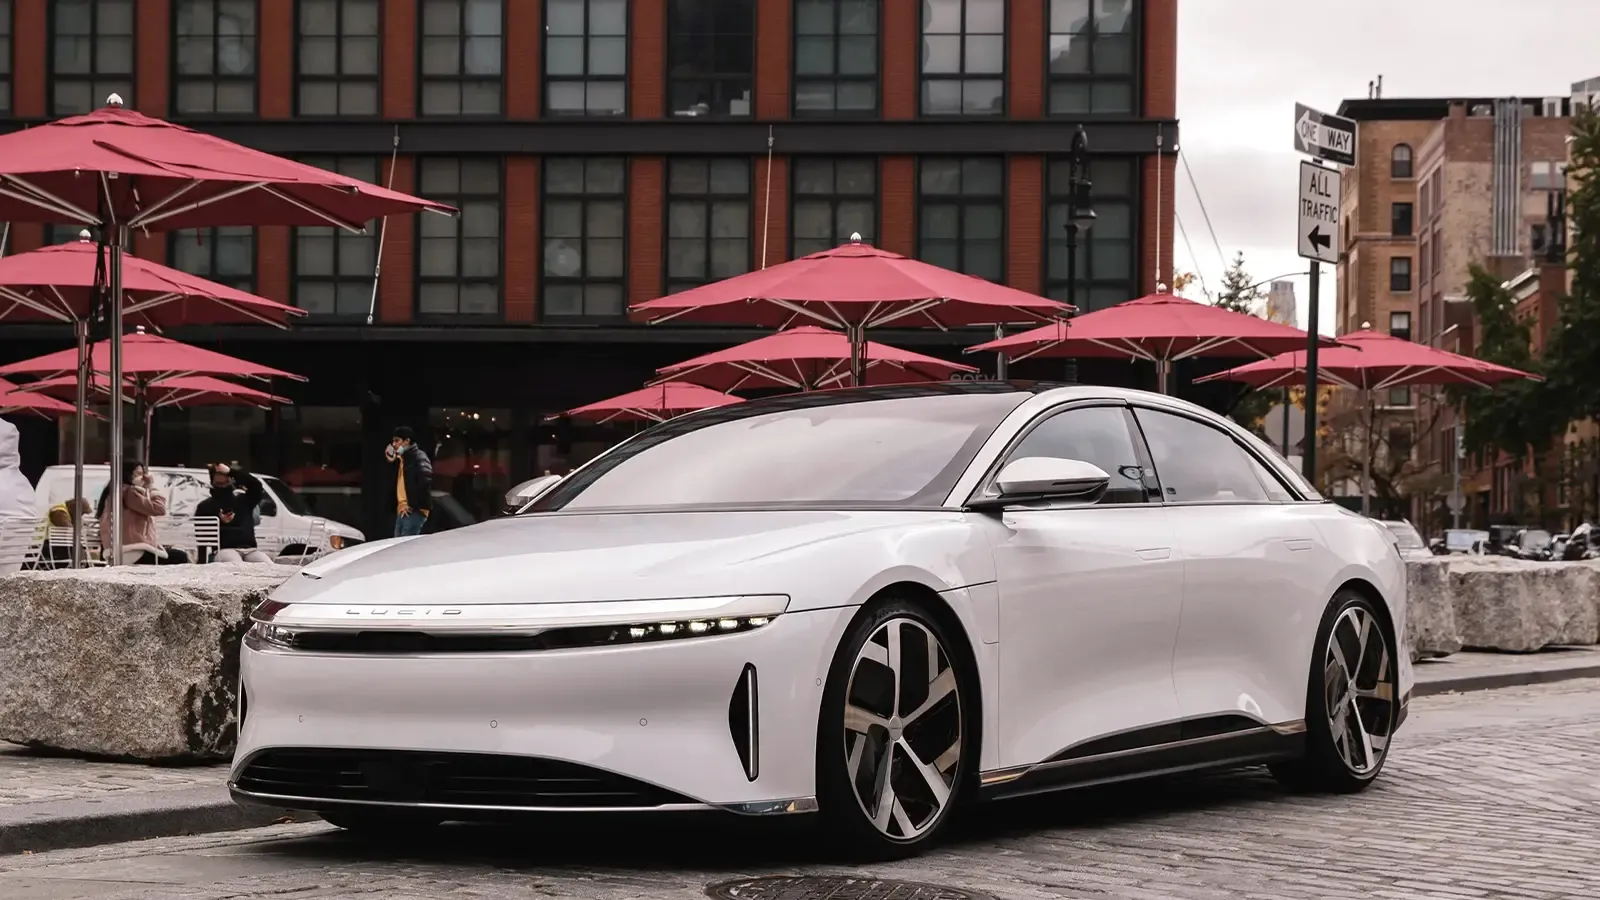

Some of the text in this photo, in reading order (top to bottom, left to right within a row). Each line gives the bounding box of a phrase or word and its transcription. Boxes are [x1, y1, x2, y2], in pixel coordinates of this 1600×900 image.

[1301, 120, 1350, 151] ONE WAY
[1309, 171, 1332, 198] ALL
[1302, 198, 1337, 224] TRAFFIC
